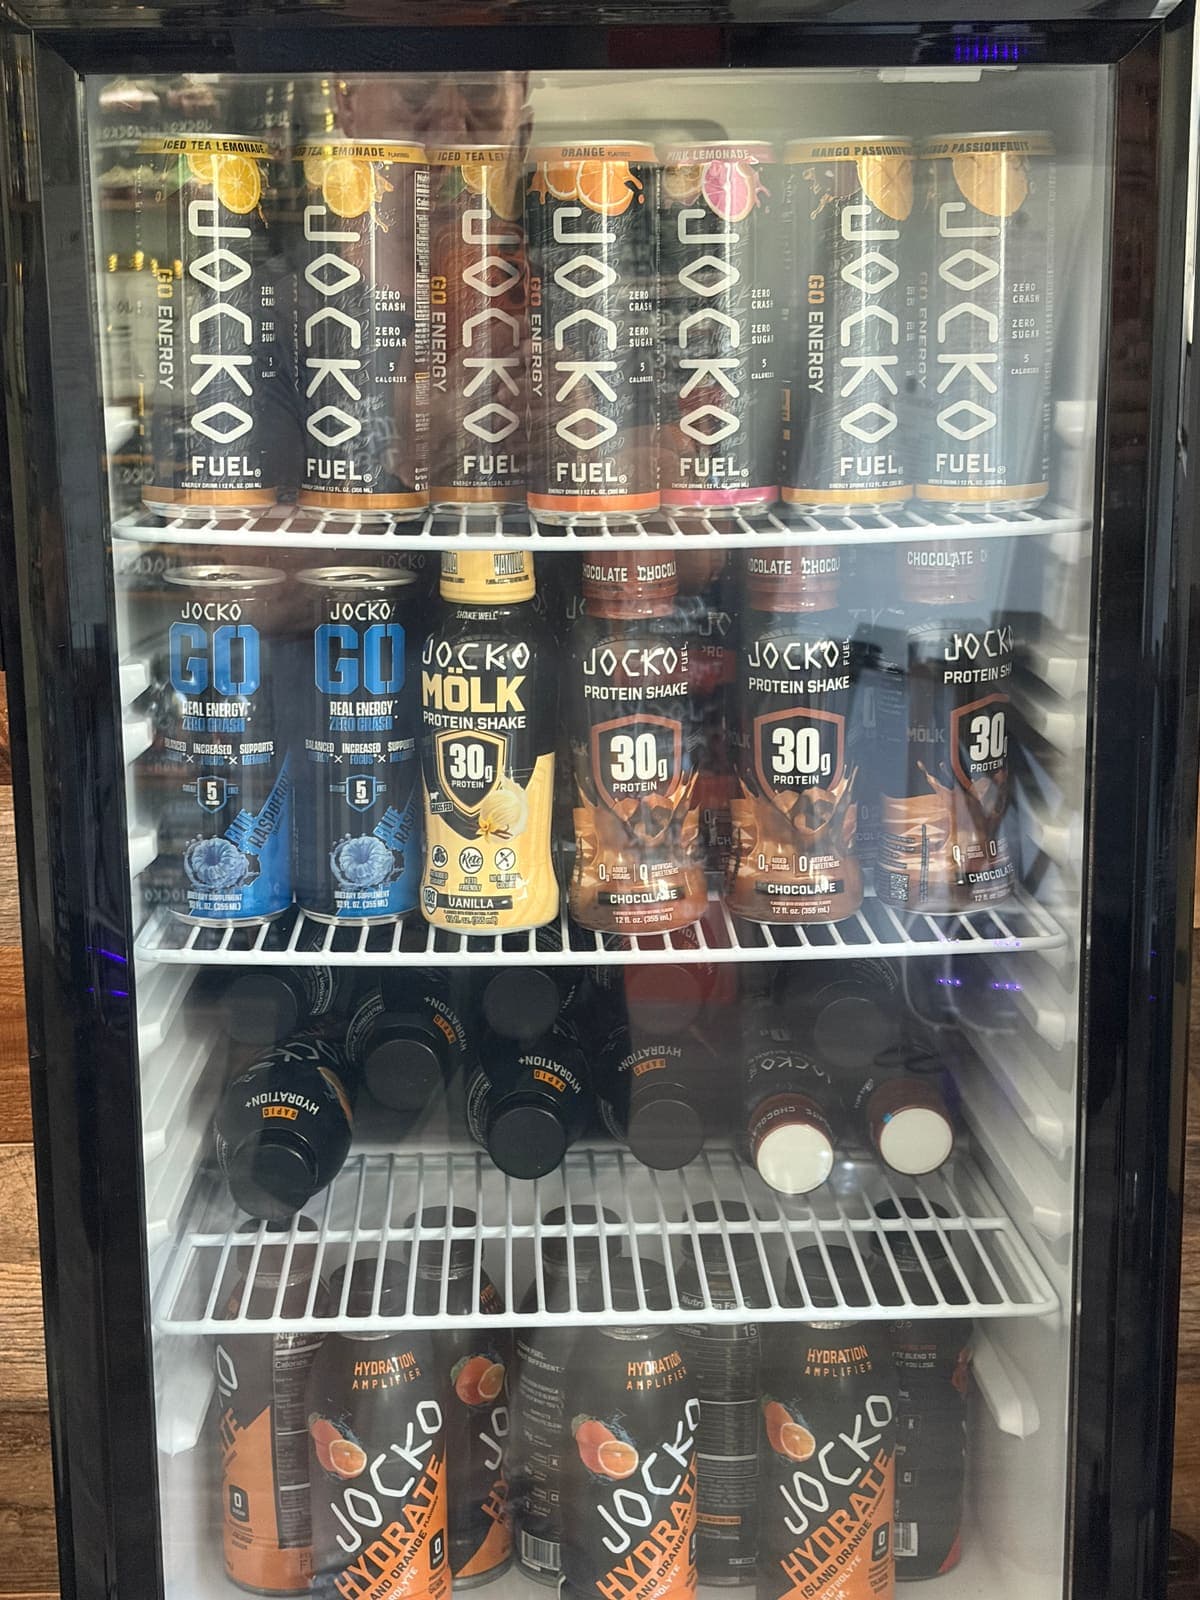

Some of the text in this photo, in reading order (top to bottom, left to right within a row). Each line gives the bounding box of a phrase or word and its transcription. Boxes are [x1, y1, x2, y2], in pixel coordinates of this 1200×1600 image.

[163, 140, 266, 154] ICED TEA LEMONADE
[326, 146, 385, 157] EMONADE
[438, 151, 485, 161] ICED TEA
[561, 147, 605, 158] ORANGE
[667, 149, 750, 161] PINK LEMONADE
[811, 146, 850, 157] MANGO
[951, 141, 1030, 153] PASSIONFRUIT
[375, 291, 400, 300] ZERO
[629, 291, 649, 300] ZERO
[751, 289, 770, 299] ZERO
[1013, 284, 1036, 292] ZERO
[375, 302, 406, 312] CRASH
[629, 302, 652, 311] CRASH
[1013, 295, 1040, 304] CRASH
[156, 268, 174, 391] GO ENERGY
[188, 200, 253, 444] JOCKO
[304, 205, 362, 447] JOCKO
[462, 210, 520, 443] JOCKO
[553, 207, 618, 450] JOCKO
[677, 208, 740, 445] JOCKO
[751, 325, 770, 335] ZERO
[840, 205, 899, 443] JOCKO
[937, 202, 1000, 441] JOCKO
[1012, 319, 1035, 328] ZERO
[375, 327, 401, 336] ZERO
[431, 276, 447, 393] GO ENERGY
[531, 277, 543, 398] GO ENERGY
[629, 327, 649, 336] ZERO
[808, 274, 825, 394] GO ENERGY
[375, 337, 407, 347] SUGAR
[629, 338, 653, 347] SUGAR
[389, 362, 395, 371] 5
[640, 362, 645, 371] 5
[762, 359, 767, 368] 5
[1024, 354, 1030, 363] 5
[192, 456, 254, 477] FUEL
[307, 458, 364, 481] FUEL
[463, 455, 520, 475] FUEL
[556, 463, 619, 483] FUEL
[679, 457, 741, 477] FUEL
[840, 455, 898, 477] FUEL
[936, 454, 996, 473] FUEL
[907, 551, 974, 567] CHOCOLATE
[182, 602, 241, 621] JOCKO
[330, 602, 390, 621] JOCKO
[456, 610, 476, 619] SHAKE
[169, 621, 260, 695] GO
[314, 623, 406, 695] GO
[422, 639, 530, 671] JOCKO
[583, 641, 689, 676] JOCKO FUEL
[748, 640, 840, 671] JOCKO
[749, 676, 850, 694] PROTEIN SHAKE
[944, 667, 998, 684] PROTEIN
[422, 667, 526, 713] MÖLK
[584, 682, 689, 700] PROTEIN SHAKE
[182, 700, 245, 717] REAL ENERGY
[330, 700, 393, 716] REAL ENERGY
[330, 716, 393, 732] ZERO CRASH
[423, 711, 526, 730] PROTEIN SHAKE
[193, 741, 274, 754] INCREASED SUPPORTS
[342, 742, 381, 754] INCREASED
[772, 727, 831, 775] 30g
[450, 743, 493, 783] 30g
[610, 733, 668, 783] 30g
[451, 780, 484, 789] PROTEIN
[612, 782, 658, 793] PROTEIN
[773, 774, 820, 785] PROTEIN
[206, 781, 218, 800] 5
[356, 780, 367, 800] 5
[989, 840, 997, 857] 0
[799, 856, 808, 872] 0
[447, 896, 494, 909] VANILLA
[424, 995, 468, 1052] HYDRATION+
[617, 1045, 682, 1072] HYDRATION+
[518, 1055, 582, 1094] HYDRATION+
[245, 1091, 320, 1116] HYDRATION+
[743, 1323, 757, 1337] 15
[807, 1344, 868, 1364] HYDRATION
[354, 1351, 416, 1377] HYDRATION
[627, 1351, 682, 1377] HYDRATION
[804, 1361, 872, 1377] AMPLIFIER
[352, 1369, 422, 1390] AMPLIFIER
[780, 1395, 892, 1535] JOCKO
[331, 1400, 442, 1552] JOCKO
[597, 1398, 699, 1553] JOCKO
[333, 1454, 443, 1600] HYDRATE
[780, 1448, 891, 1588] HYDRATE
[878, 1531, 885, 1546] 0
[390, 1529, 428, 1579] ORANGE
[656, 1526, 689, 1578] ORANGE
[801, 1519, 872, 1600] ISLAND ORANGE
